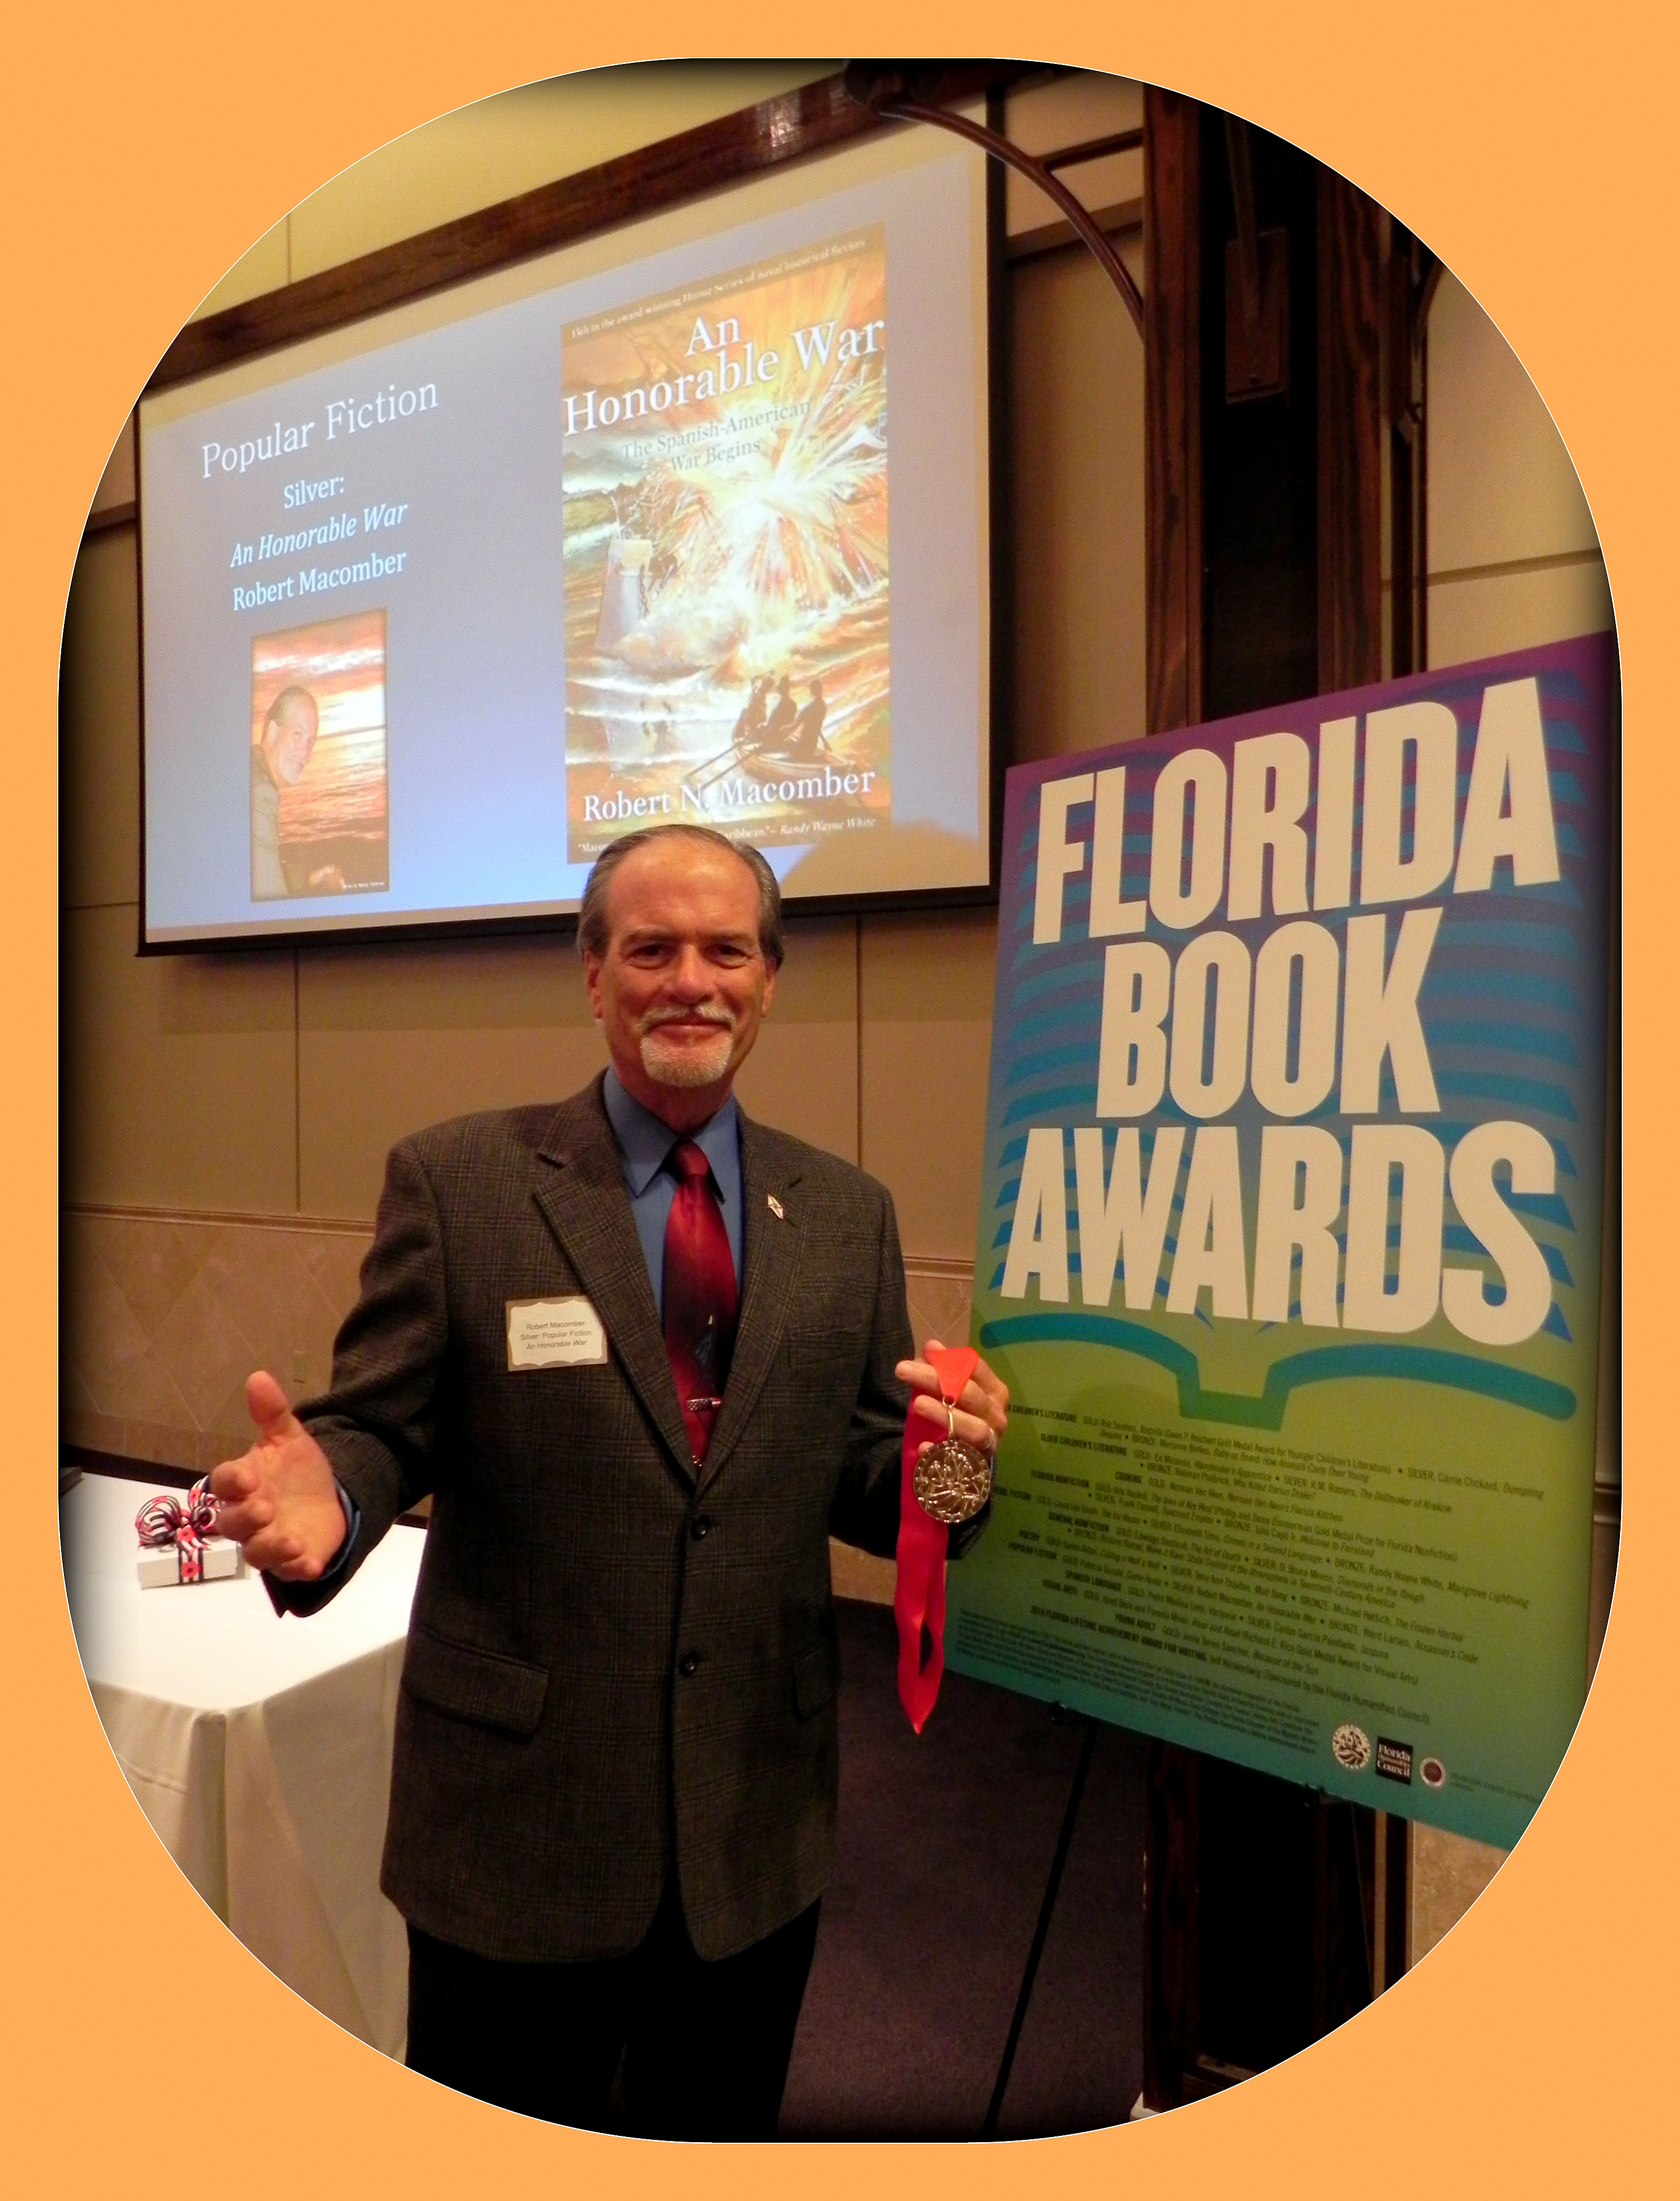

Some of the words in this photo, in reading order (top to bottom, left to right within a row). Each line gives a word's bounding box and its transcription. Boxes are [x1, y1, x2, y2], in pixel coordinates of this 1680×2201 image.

[685, 317, 741, 357] An
[563, 341, 780, 437] Honorable
[792, 319, 885, 371] War
[201, 420, 315, 478] Popular
[326, 382, 438, 441] Fiction
[621, 440, 654, 461] The
[657, 402, 811, 453] Spanish-American
[670, 452, 702, 473] War
[705, 437, 761, 466] Begins
[283, 476, 345, 509] Silver:
[230, 543, 253, 569] An
[258, 514, 357, 561] Honorable
[363, 503, 408, 533] War
[233, 575, 294, 611] Robert
[299, 553, 407, 595] Macomber
[583, 790, 671, 822] Robert
[719, 766, 876, 806] Macomber
[1033, 677, 1561, 945] FLORIDA
[846, 817, 877, 829] White
[1095, 906, 1443, 1119] BOOK
[1000, 1119, 1557, 1346] AWARDS
[526, 1322, 549, 1331] Robert
[542, 1330, 568, 1339] Popular
[1377, 1760, 1410, 1778] Council
[1378, 1744, 1410, 1762] Florida
